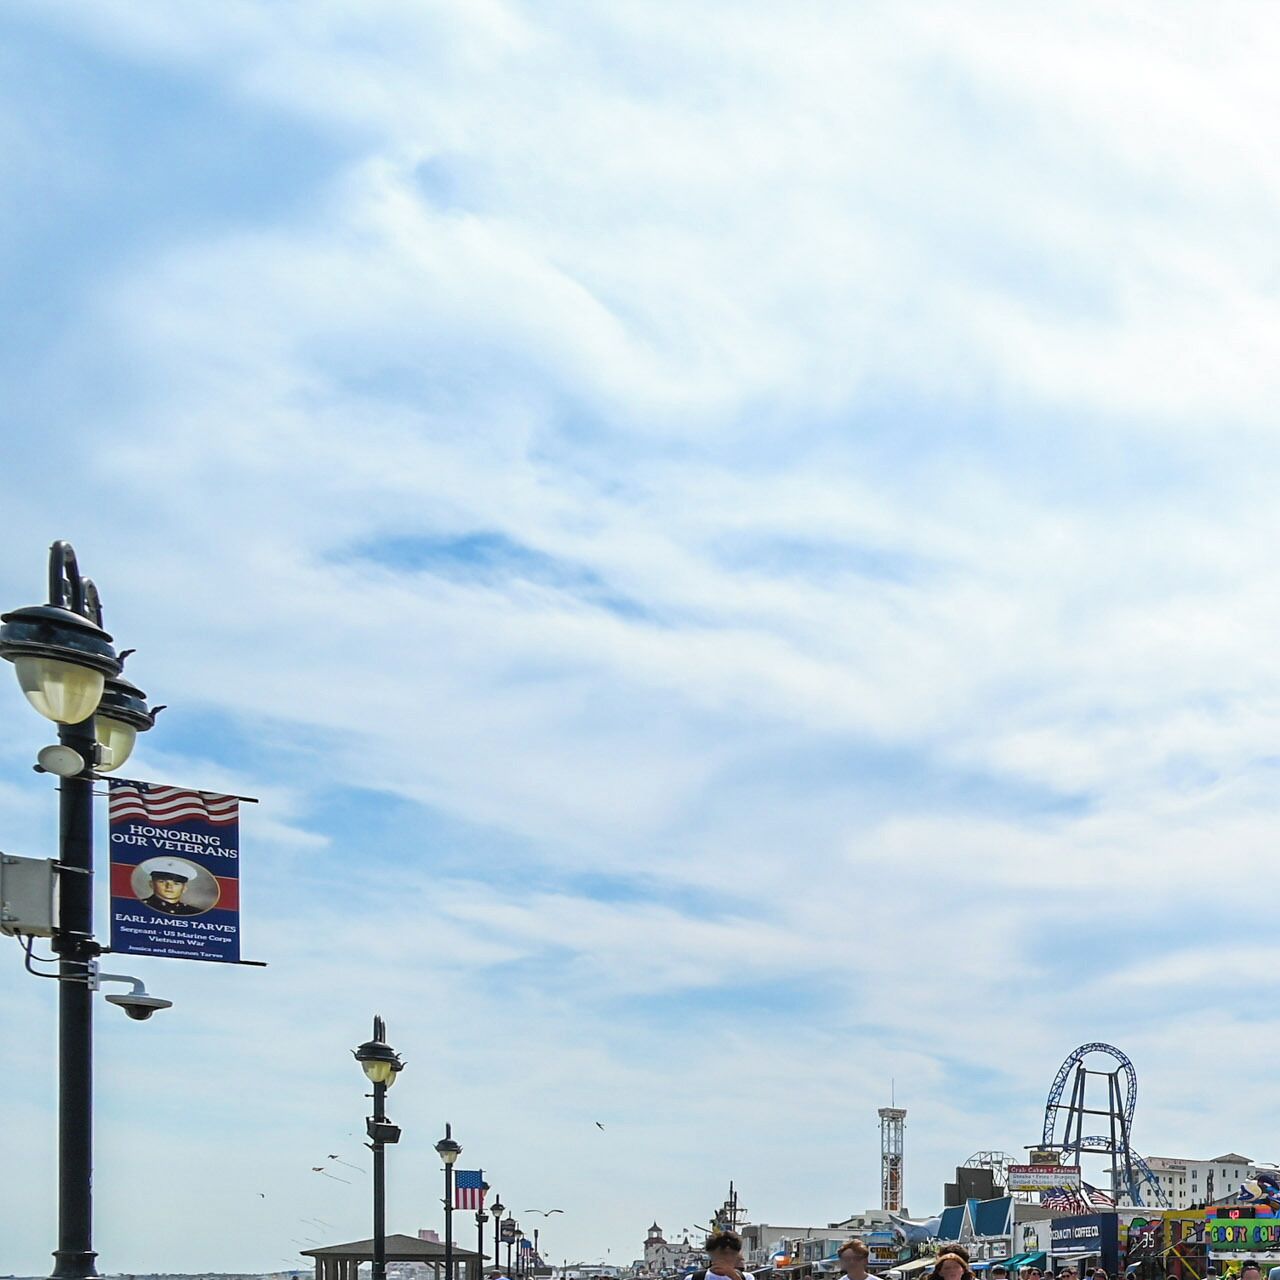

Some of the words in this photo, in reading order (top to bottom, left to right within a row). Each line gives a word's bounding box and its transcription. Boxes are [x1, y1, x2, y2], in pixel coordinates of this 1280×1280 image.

[130, 824, 220, 846] HONORING
[111, 833, 148, 847] OUR
[152, 839, 238, 859] VETERANS
[115, 913, 148, 924] EARL
[149, 917, 189, 928] JAMES
[190, 921, 236, 933] TARVES
[120, 926, 157, 936] Sergeant
[177, 931, 207, 940] Marine
[208, 935, 232, 943] Corps
[148, 936, 185, 945] Vietnam
[1063, 1228, 1072, 1239] CITY
[1075, 1227, 1091, 1238] COFFEE
[1211, 1225, 1247, 1243] GOOFY
